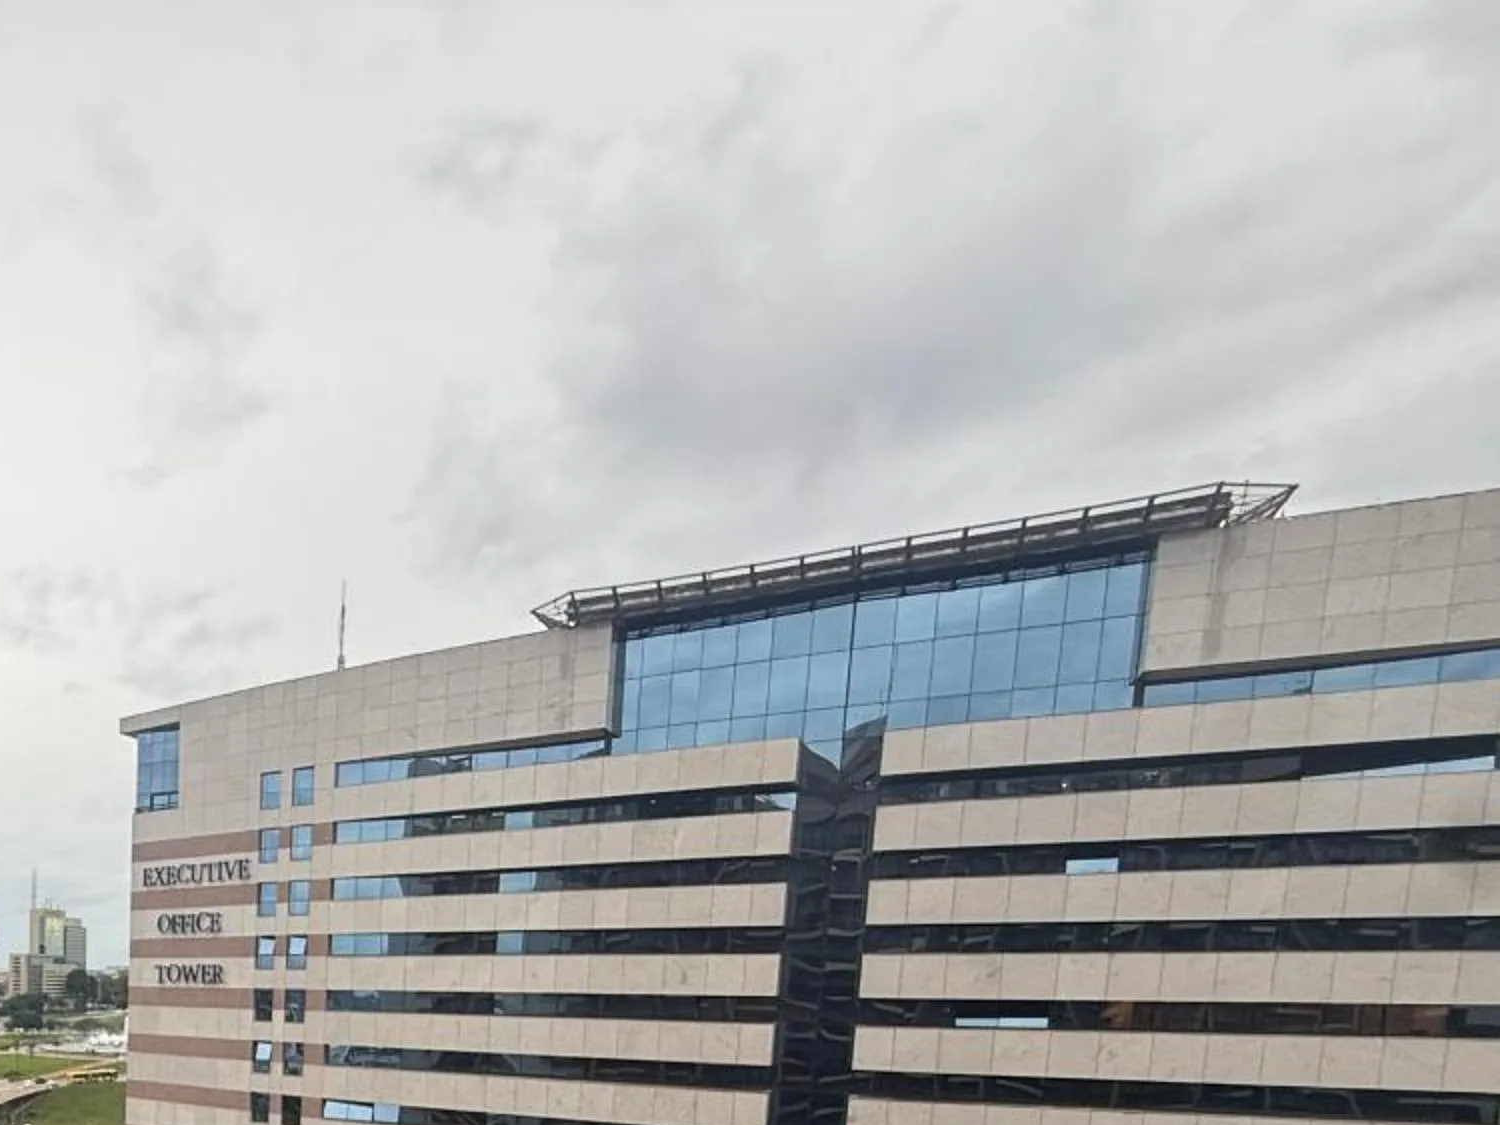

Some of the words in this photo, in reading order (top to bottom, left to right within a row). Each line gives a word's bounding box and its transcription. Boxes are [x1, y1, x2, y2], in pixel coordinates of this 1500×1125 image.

[143, 858, 252, 887] EXECUTIVE
[157, 911, 223, 934] OFFICE
[154, 963, 225, 985] TOWER
